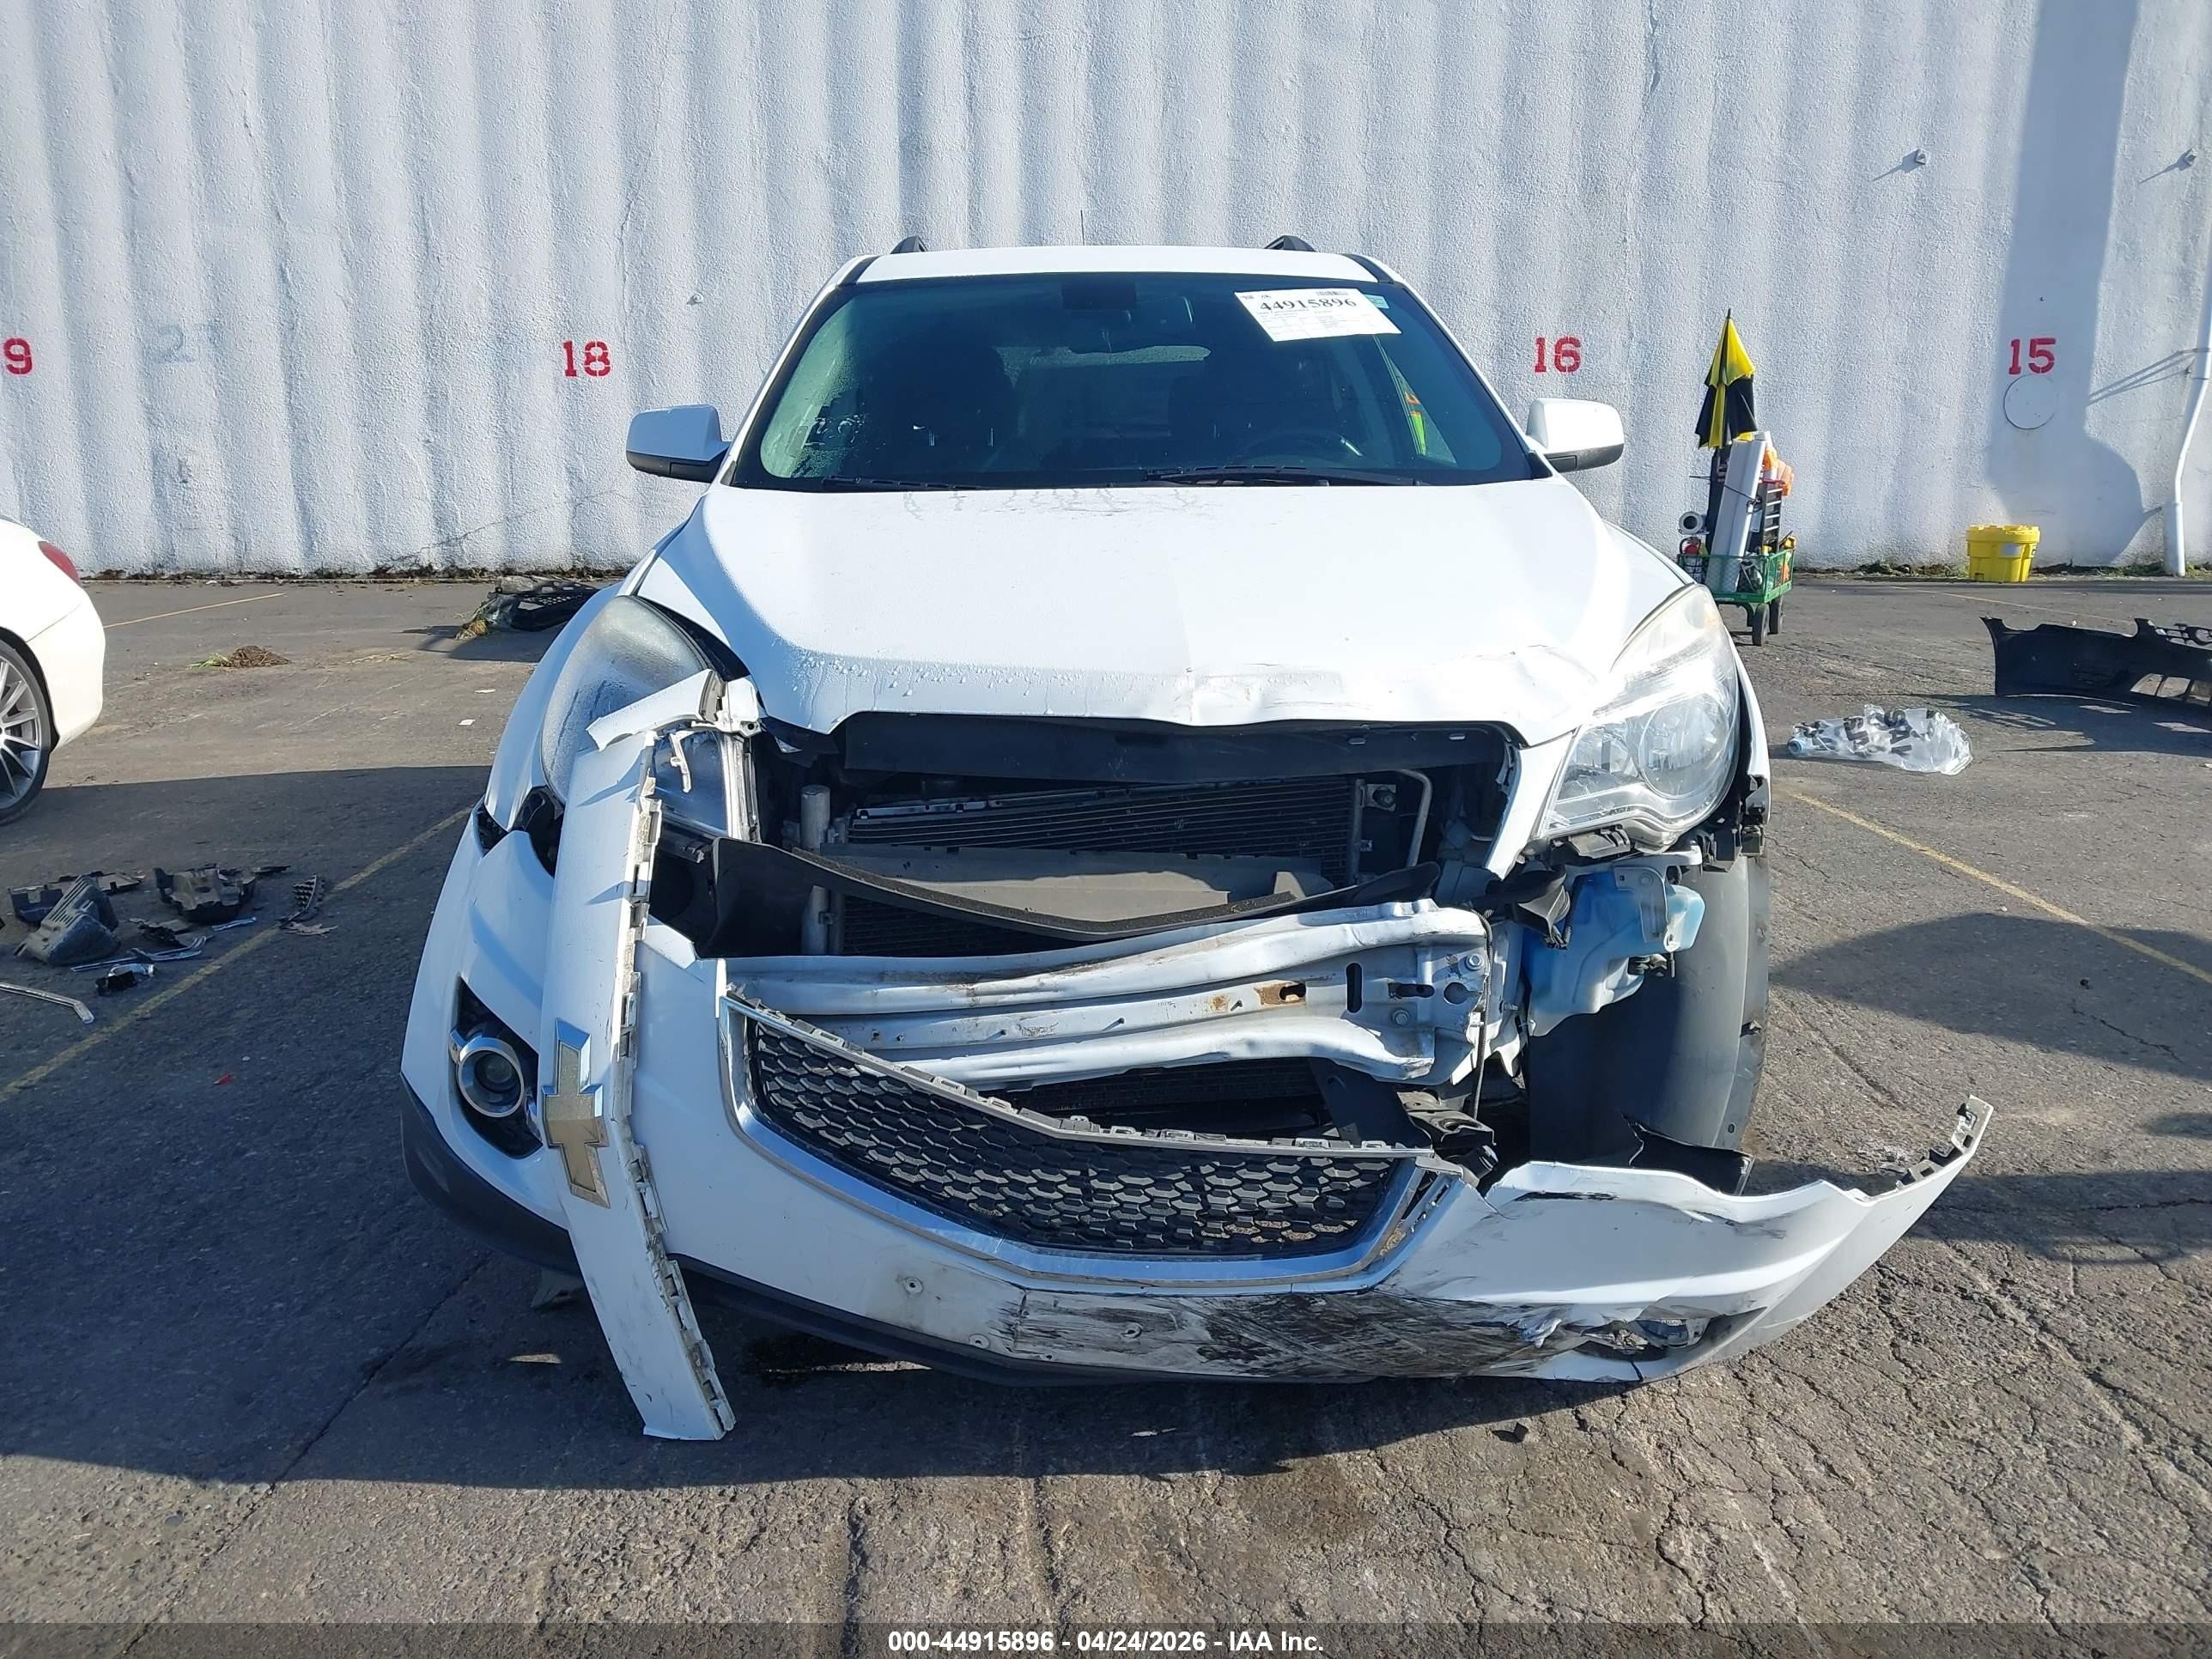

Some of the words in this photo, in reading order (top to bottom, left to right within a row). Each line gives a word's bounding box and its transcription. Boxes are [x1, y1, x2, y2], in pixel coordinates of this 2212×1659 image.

[1260, 298, 1358, 311] 44915896
[563, 342, 611, 378] 18
[1534, 337, 1581, 374] 16
[2008, 340, 2057, 375] 15
